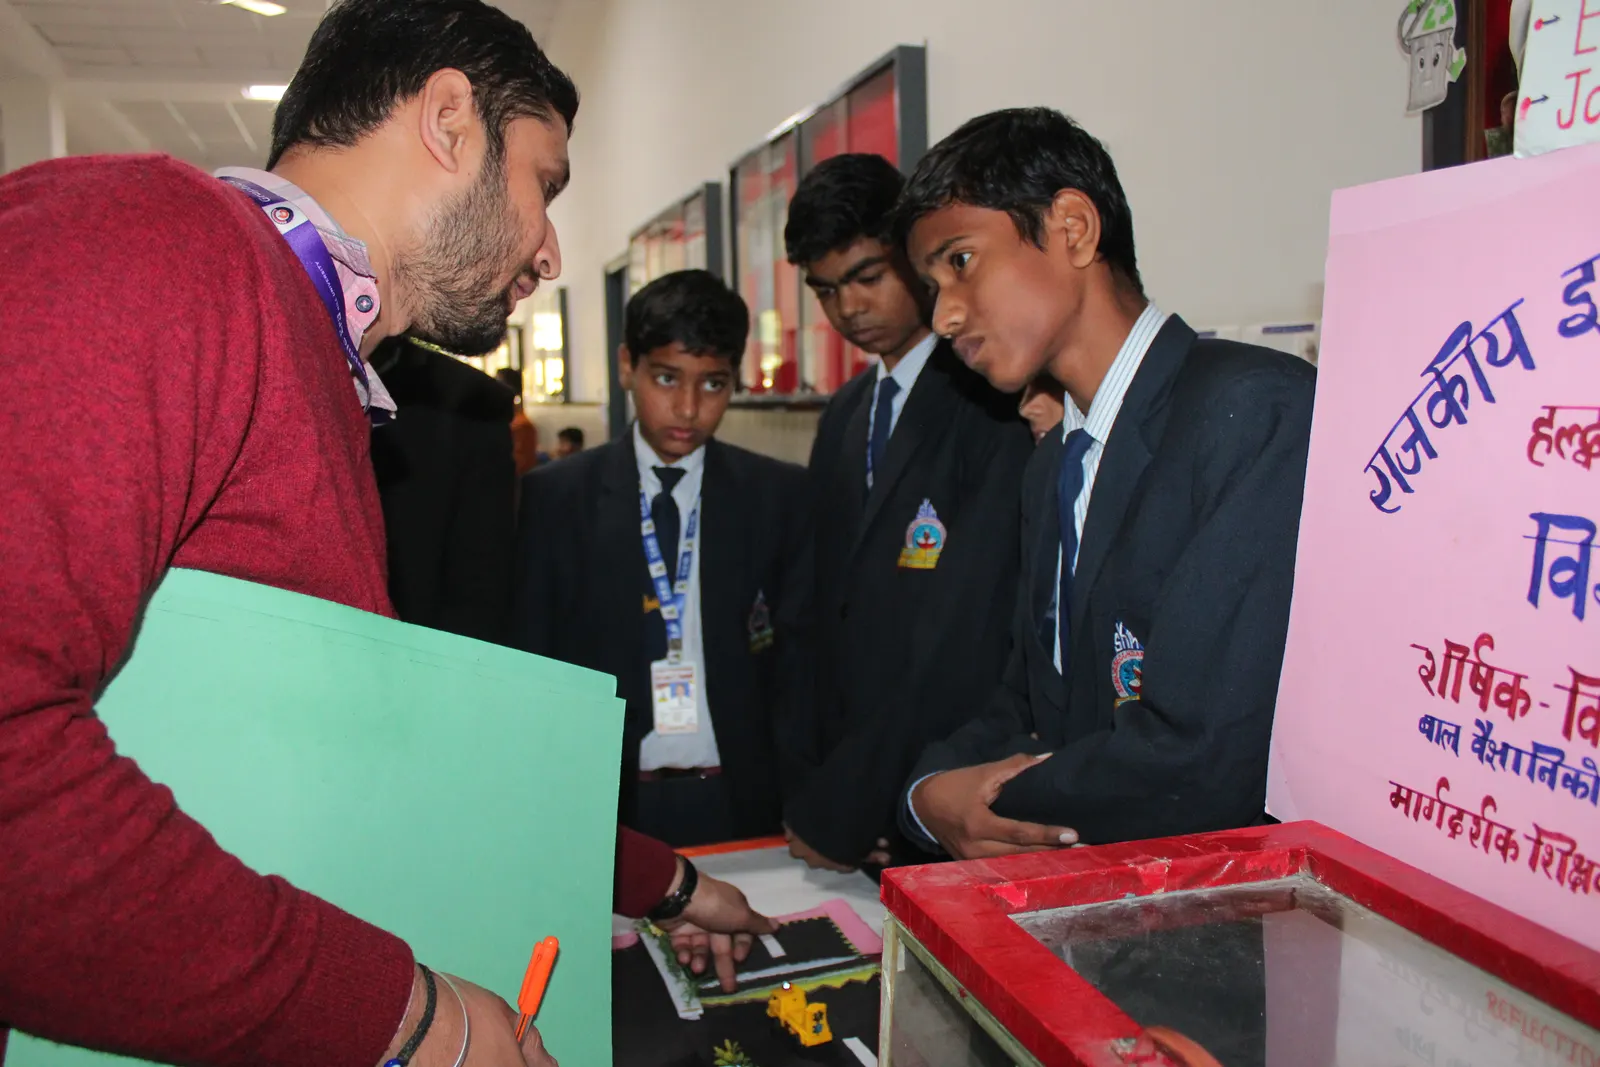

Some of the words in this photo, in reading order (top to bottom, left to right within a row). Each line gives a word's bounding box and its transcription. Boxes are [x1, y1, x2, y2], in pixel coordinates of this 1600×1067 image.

[314, 261, 336, 297] UNIVERSITY
[1364, 297, 1536, 514] राजकीय
[1418, 714, 1462, 758] बाल
[1486, 988, 1600, 1067] REFLECTIO
